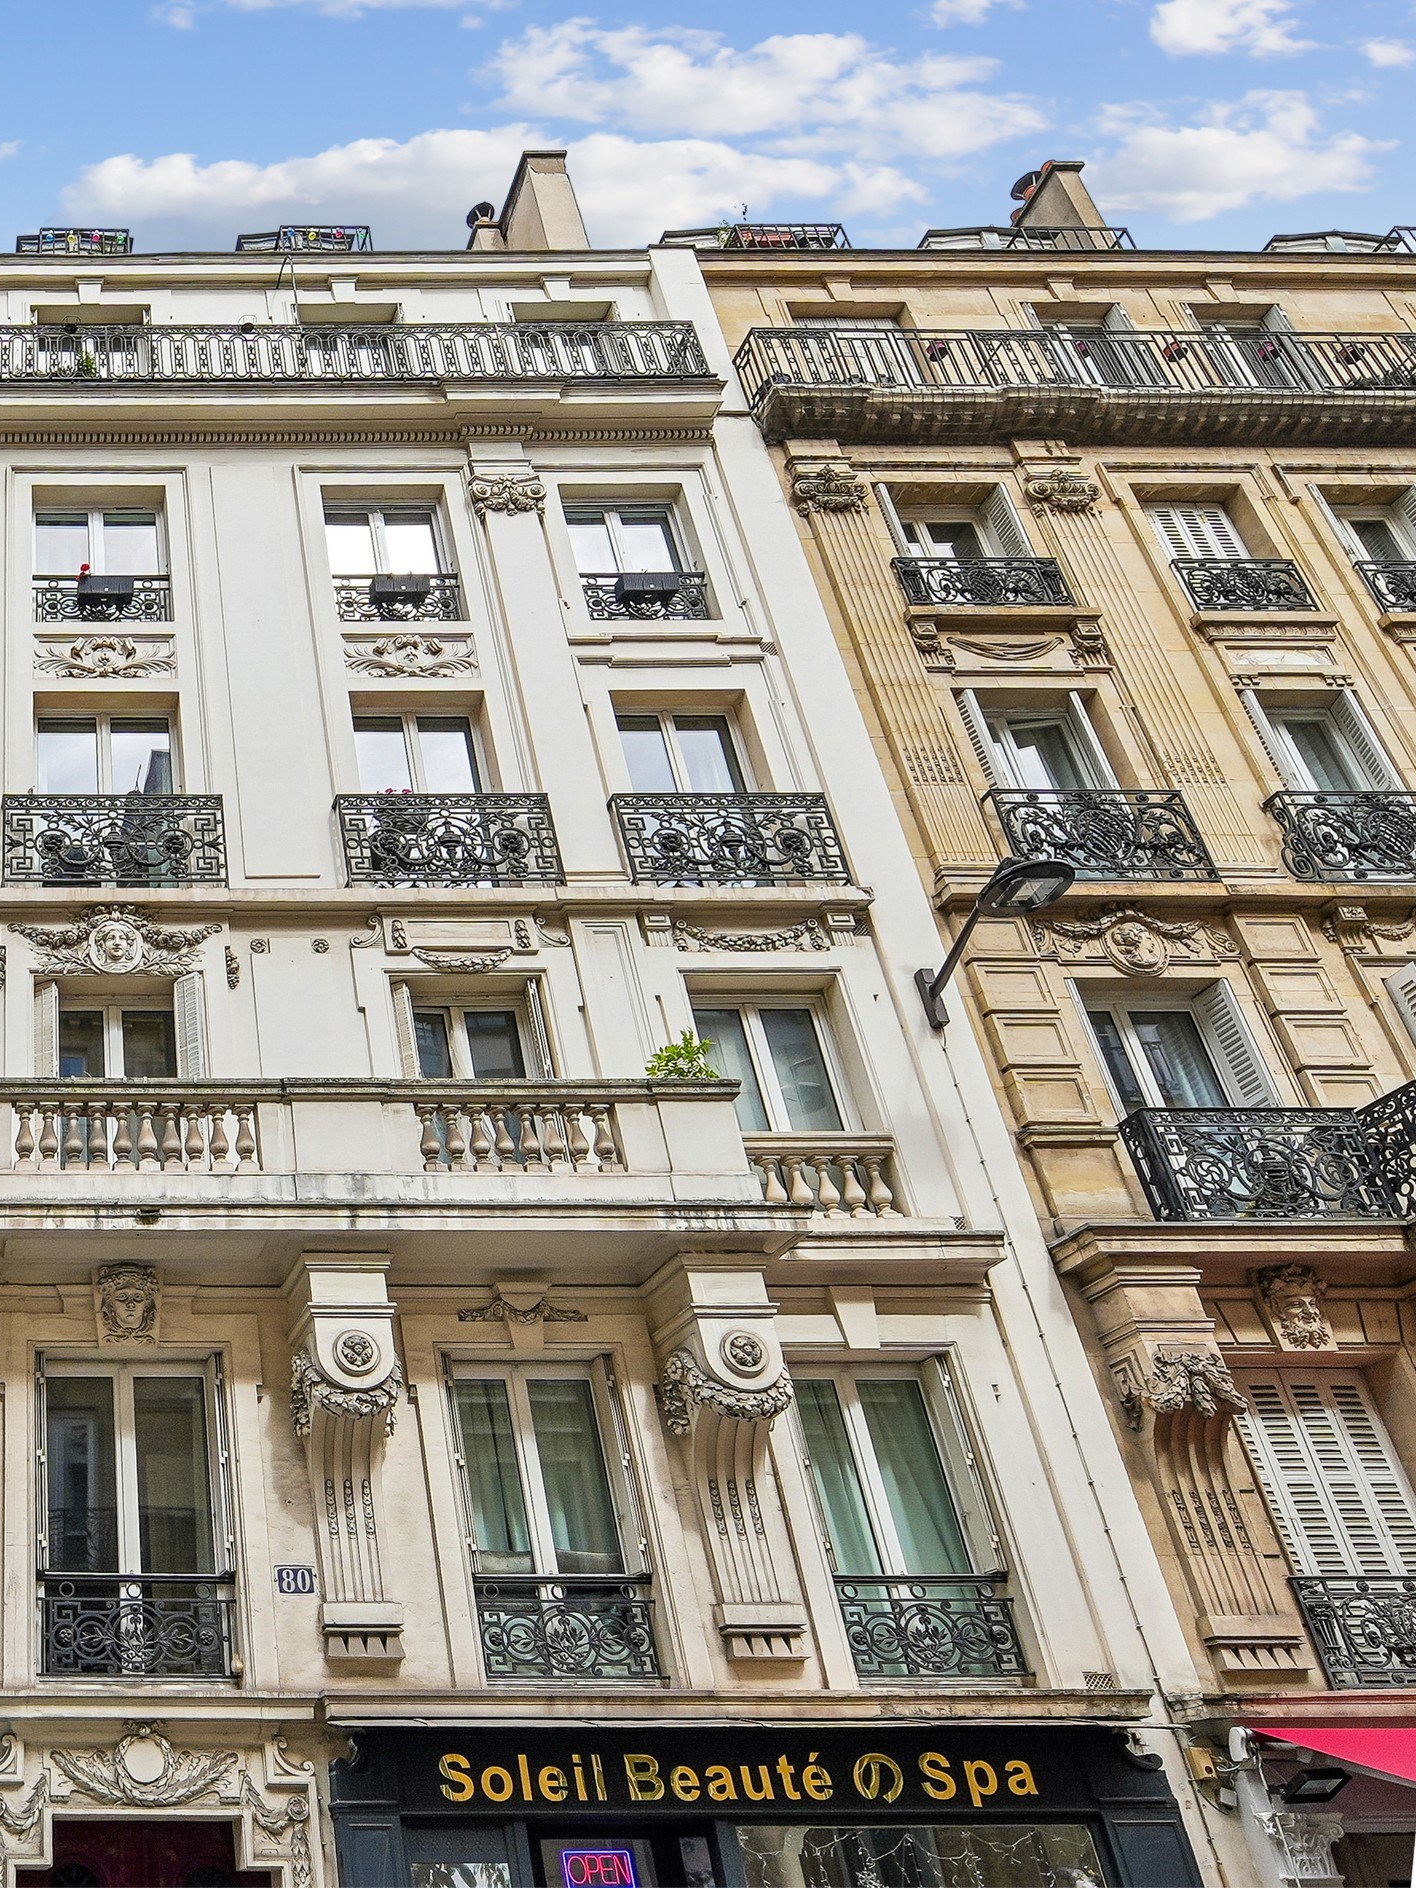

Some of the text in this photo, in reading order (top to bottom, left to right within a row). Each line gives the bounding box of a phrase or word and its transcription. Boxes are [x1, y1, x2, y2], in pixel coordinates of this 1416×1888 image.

[282, 1569, 311, 1593] 80
[438, 1753, 608, 1802] Soleil
[623, 1752, 834, 1802] Beauté
[918, 1751, 1039, 1808] Spa
[567, 1855, 631, 1885] OPEN
